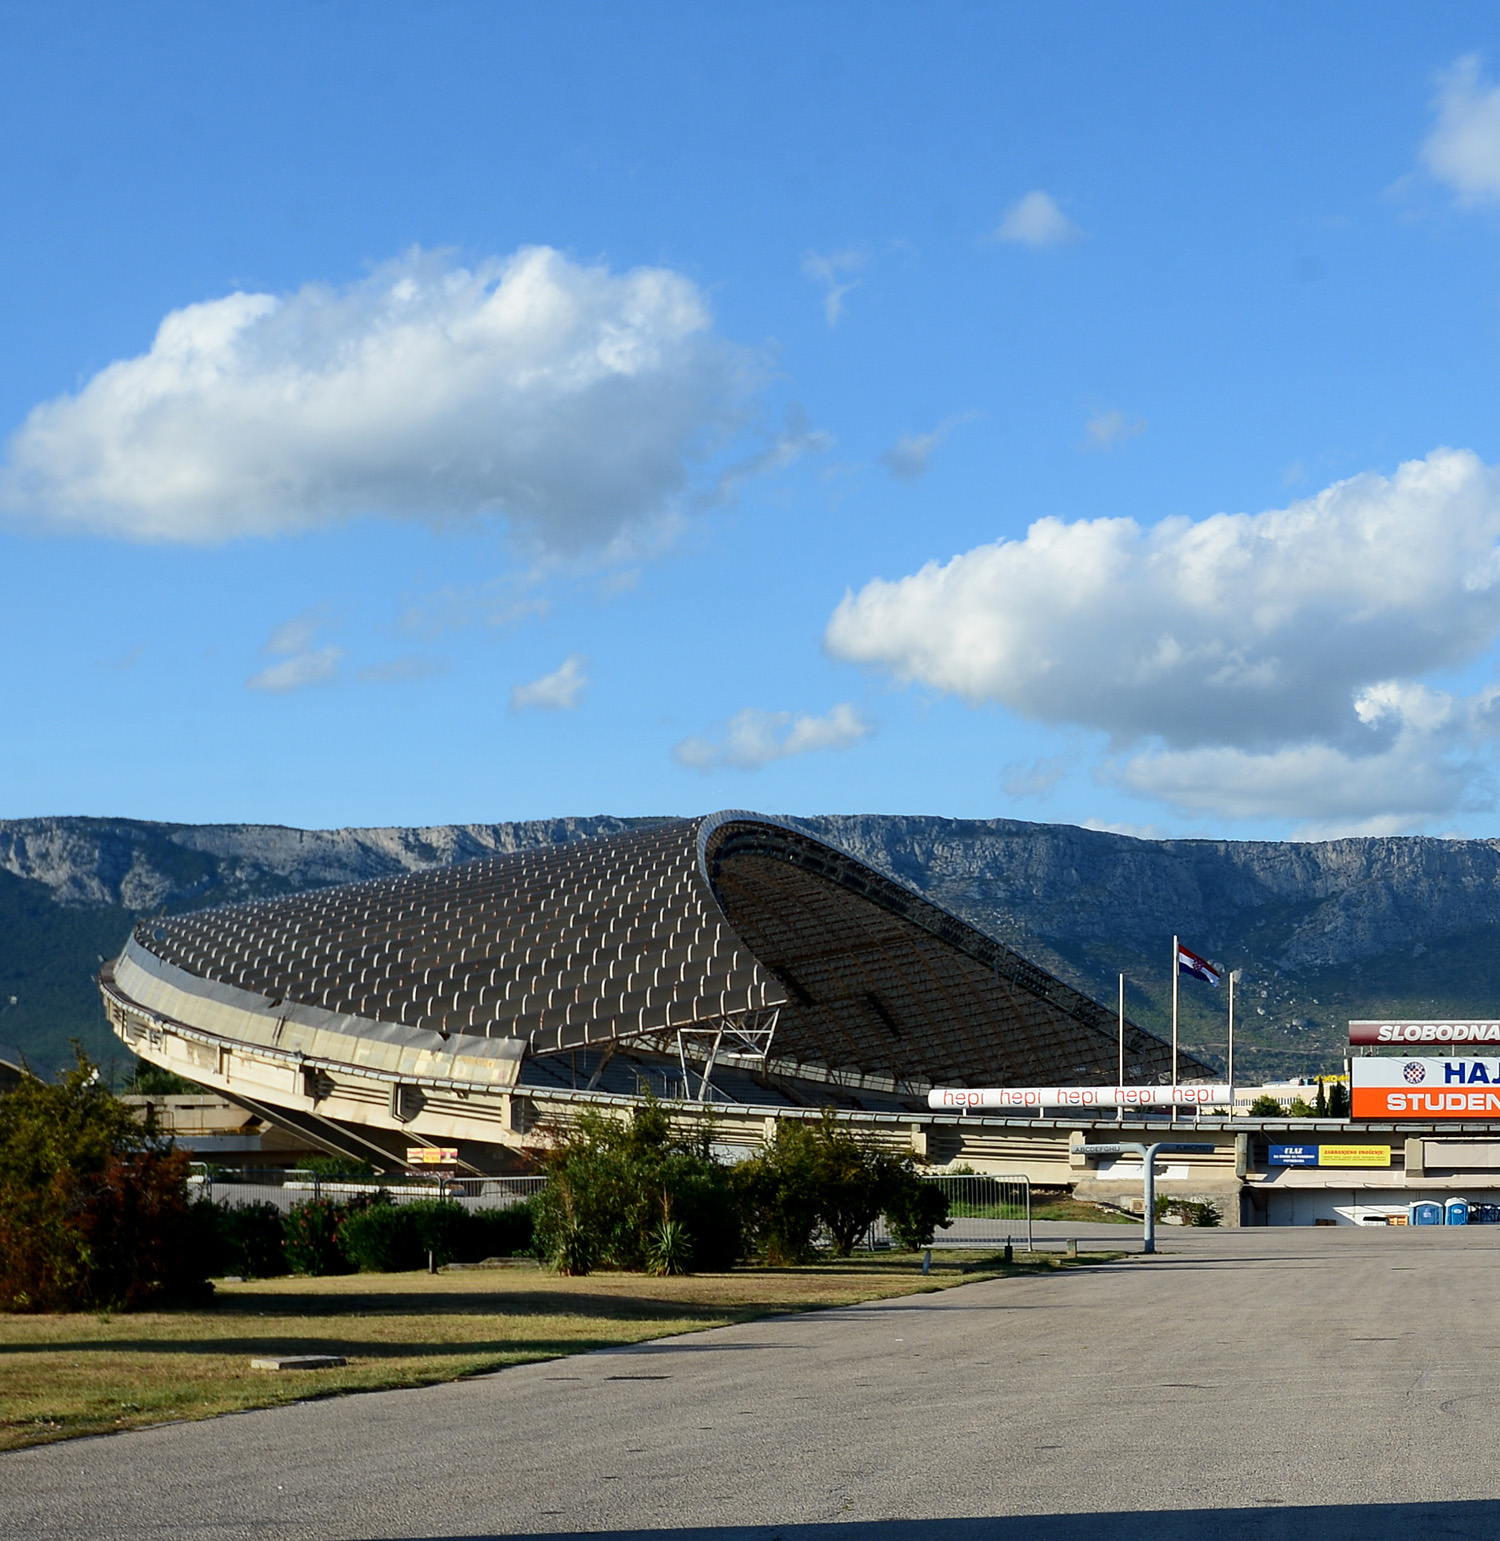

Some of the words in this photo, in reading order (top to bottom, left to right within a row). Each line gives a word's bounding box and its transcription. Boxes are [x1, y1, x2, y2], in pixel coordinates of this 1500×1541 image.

[1377, 1024, 1500, 1041] SLOBODNA
[943, 1089, 985, 1108] hepi
[1000, 1089, 1042, 1107] hepi
[1057, 1088, 1099, 1107] hepi
[1114, 1087, 1156, 1105] hepi
[1172, 1086, 1214, 1104] hepi
